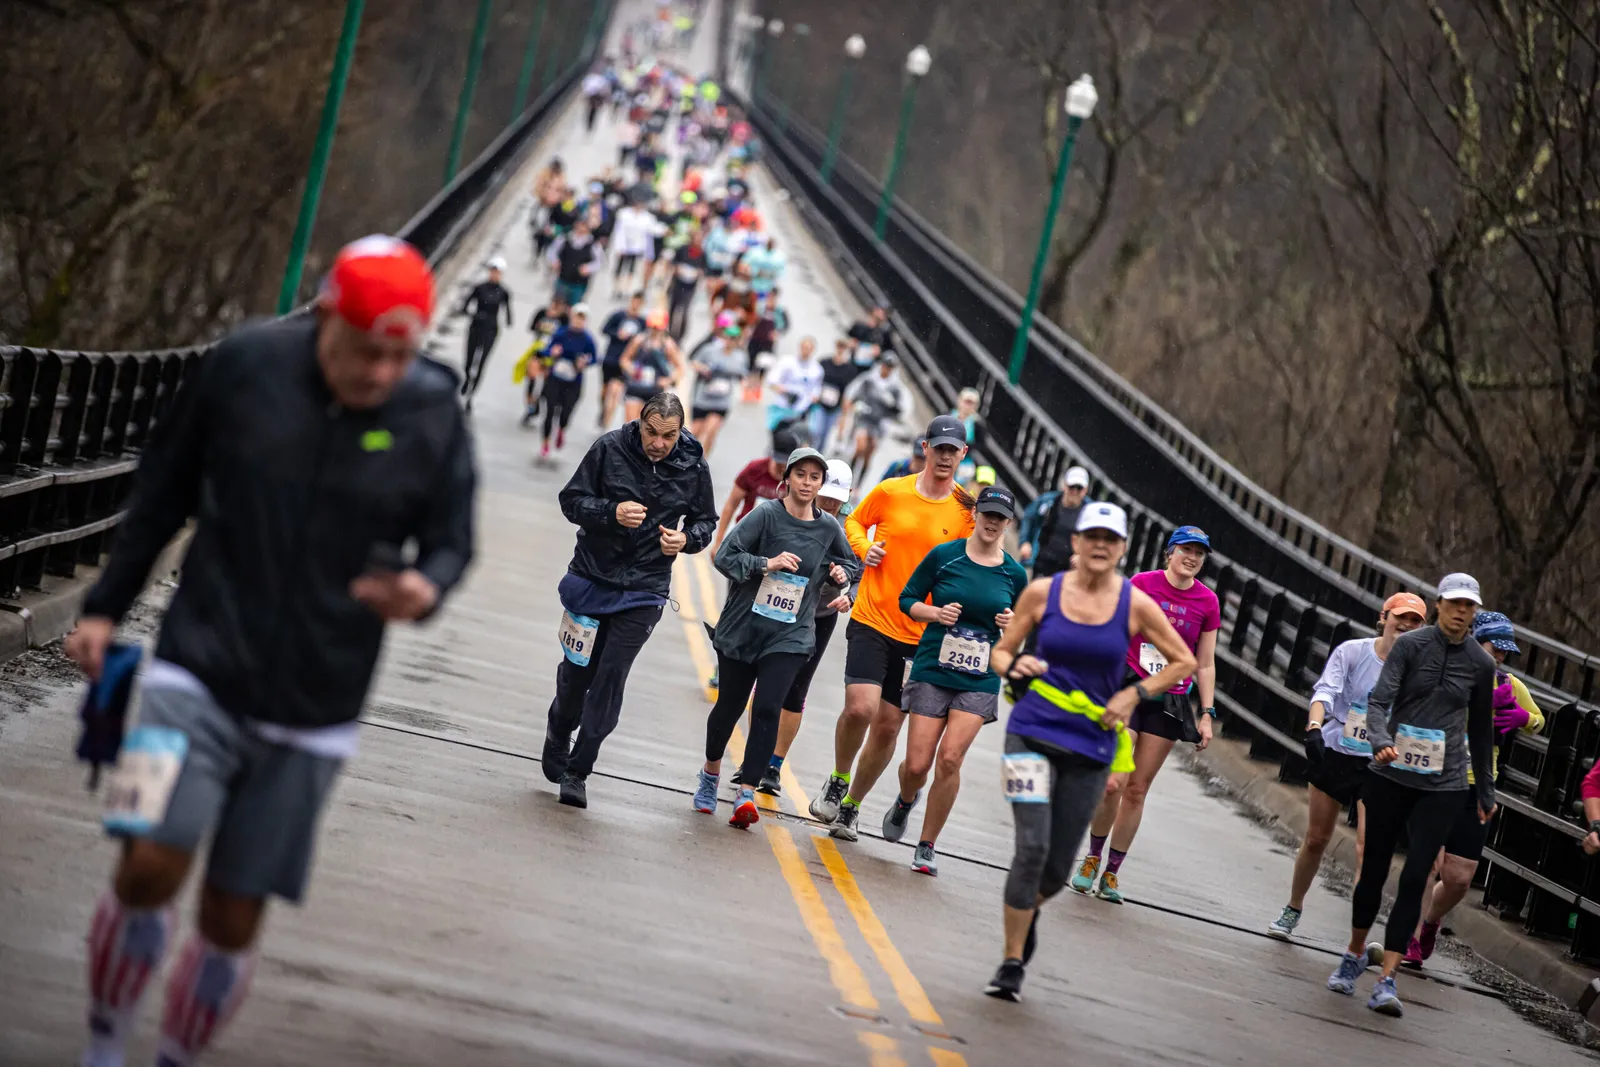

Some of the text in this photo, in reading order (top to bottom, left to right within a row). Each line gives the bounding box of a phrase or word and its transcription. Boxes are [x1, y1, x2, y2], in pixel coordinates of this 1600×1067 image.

[766, 593, 795, 611] 1065
[563, 631, 584, 652] 1819
[948, 651, 981, 668] 2346
[1149, 662, 1168, 673] 18
[1353, 727, 1370, 741] 18
[1404, 752, 1430, 767] 975
